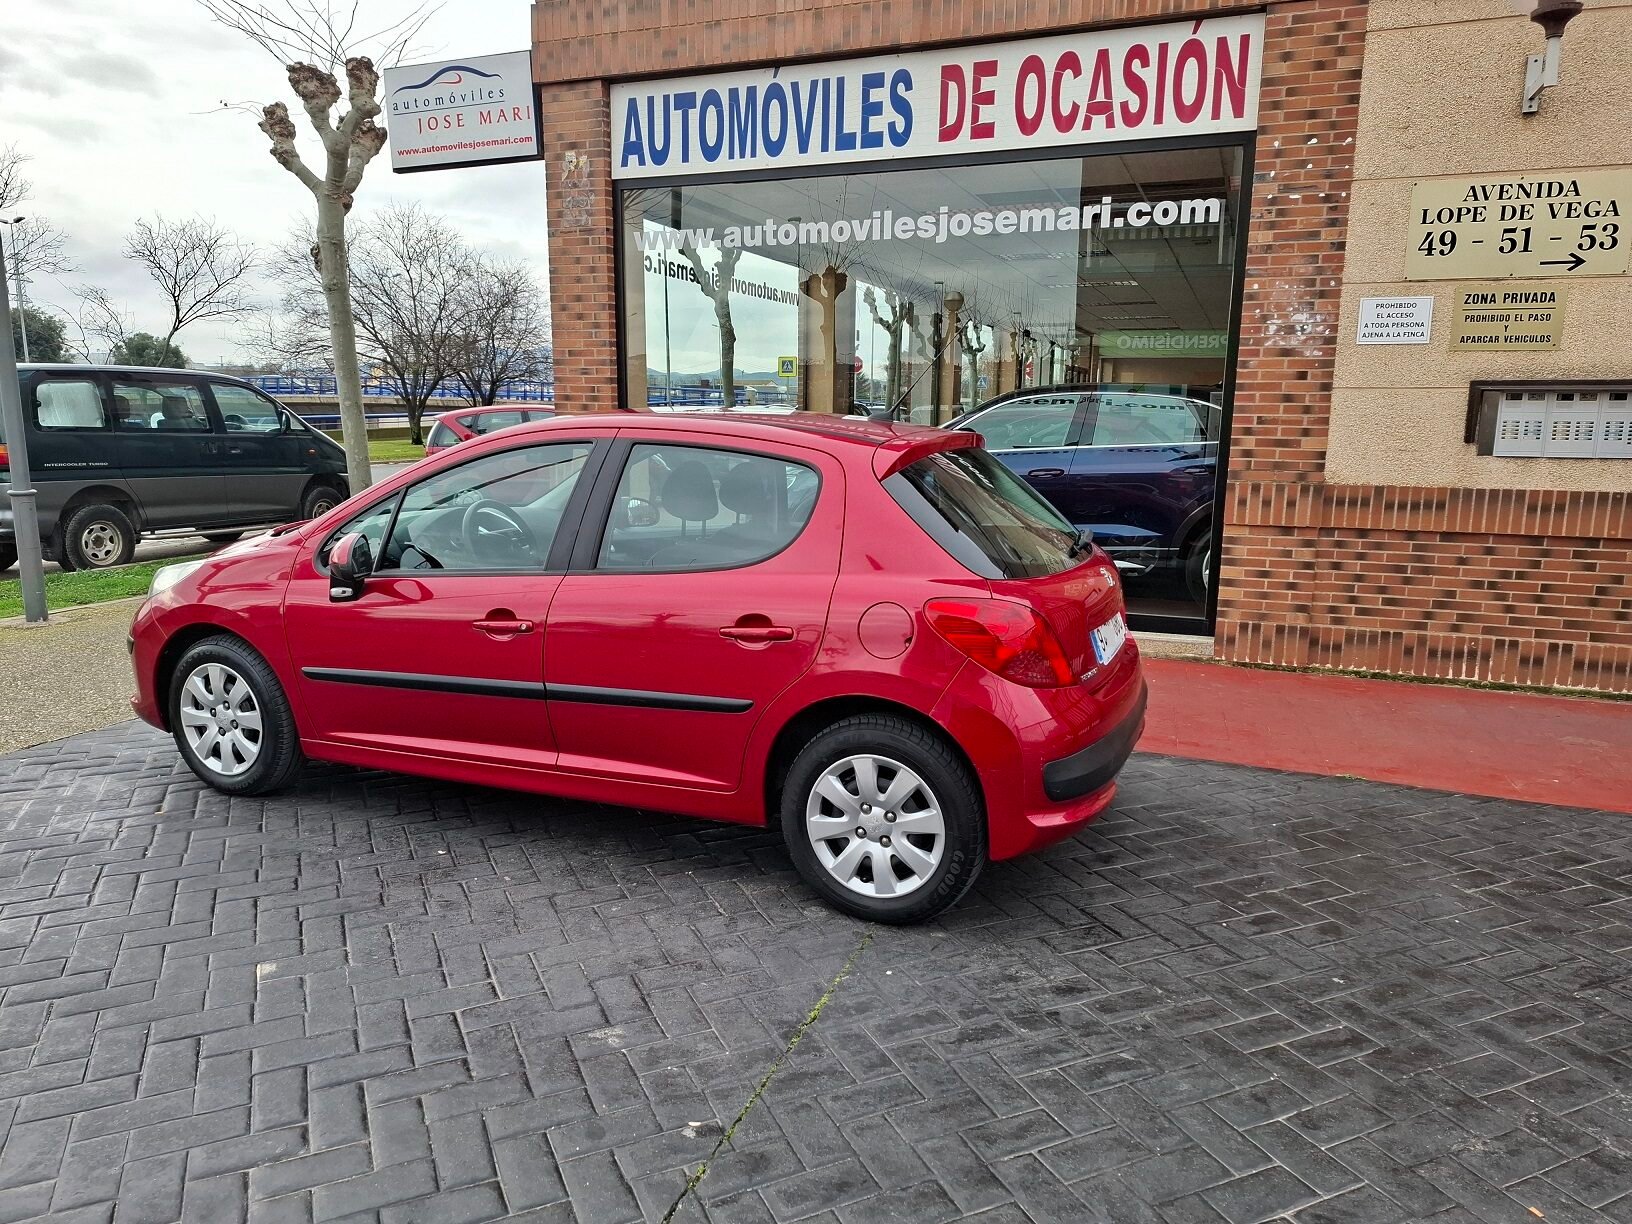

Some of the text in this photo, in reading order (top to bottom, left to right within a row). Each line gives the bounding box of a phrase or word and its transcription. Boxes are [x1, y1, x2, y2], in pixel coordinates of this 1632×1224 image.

[392, 87, 505, 111] automóviles
[620, 20, 1251, 168] AUTOMÓVILES DE OCASIÓN
[417, 105, 531, 134] JOSE MARI
[397, 135, 533, 156] www.automovilesjosemari.com
[1462, 180, 1581, 202] AVENIDA
[1420, 200, 1620, 225] LOPE DE VEGA
[633, 197, 1220, 251] www.automovilesjosemari.com
[1417, 230, 1457, 256] 49
[1498, 227, 1533, 254] 51
[1577, 223, 1620, 251] 53
[1375, 302, 1417, 310] PROHIBIDO
[1463, 291, 1556, 305] ZONA PRIVADA
[1464, 313, 1552, 323] PROHIBIDO EL PASO
[1503, 325, 1509, 333] Y
[1459, 334, 1551, 344] APARCAR VEHICULOS
